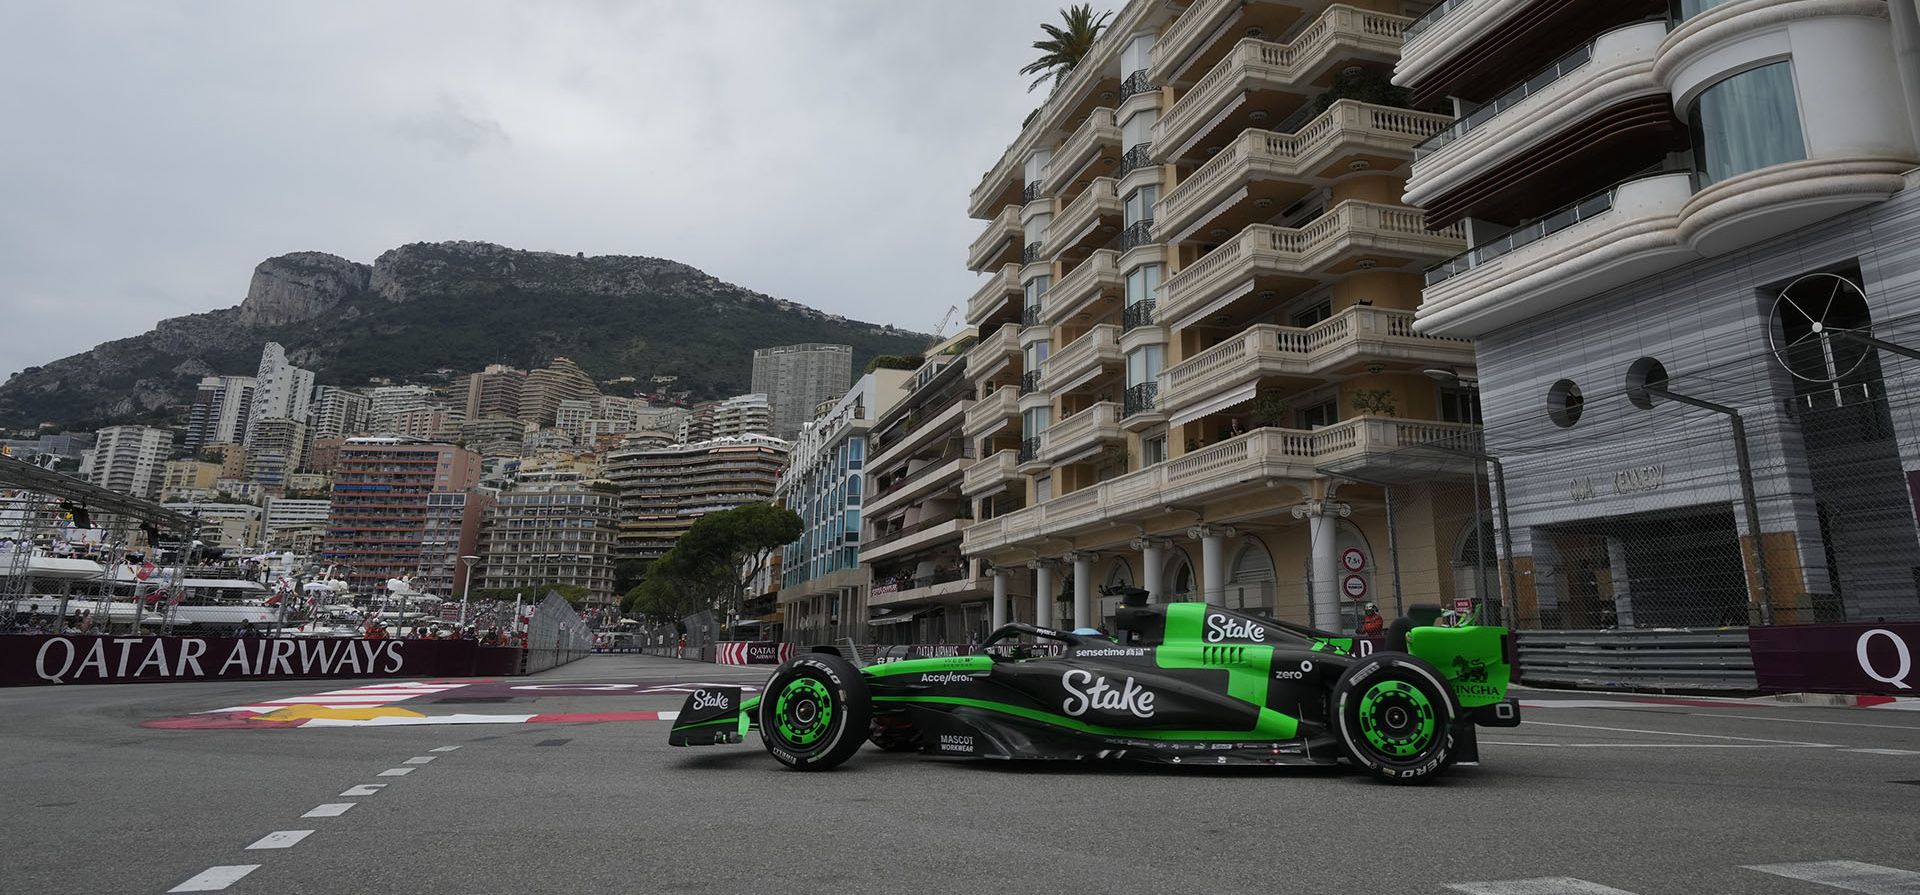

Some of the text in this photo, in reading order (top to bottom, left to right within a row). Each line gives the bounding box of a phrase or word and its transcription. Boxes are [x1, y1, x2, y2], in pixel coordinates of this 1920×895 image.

[1207, 614, 1265, 643] Stake
[750, 647, 776, 656] QATAR
[916, 645, 934, 658] QATAR
[1076, 648, 1125, 657] sensetime
[1856, 629, 1913, 689] Q
[35, 637, 404, 684] QATAR AIRWAYS
[793, 659, 841, 685] P ZERO
[1275, 671, 1303, 680] zero
[693, 688, 729, 710] Stake
[1062, 669, 1156, 718] Stake
[1453, 684, 1500, 697] INGHA
[940, 735, 974, 745] MASCOT
[940, 743, 974, 753] WORKWEAR
[1401, 750, 1448, 778] ZERO
